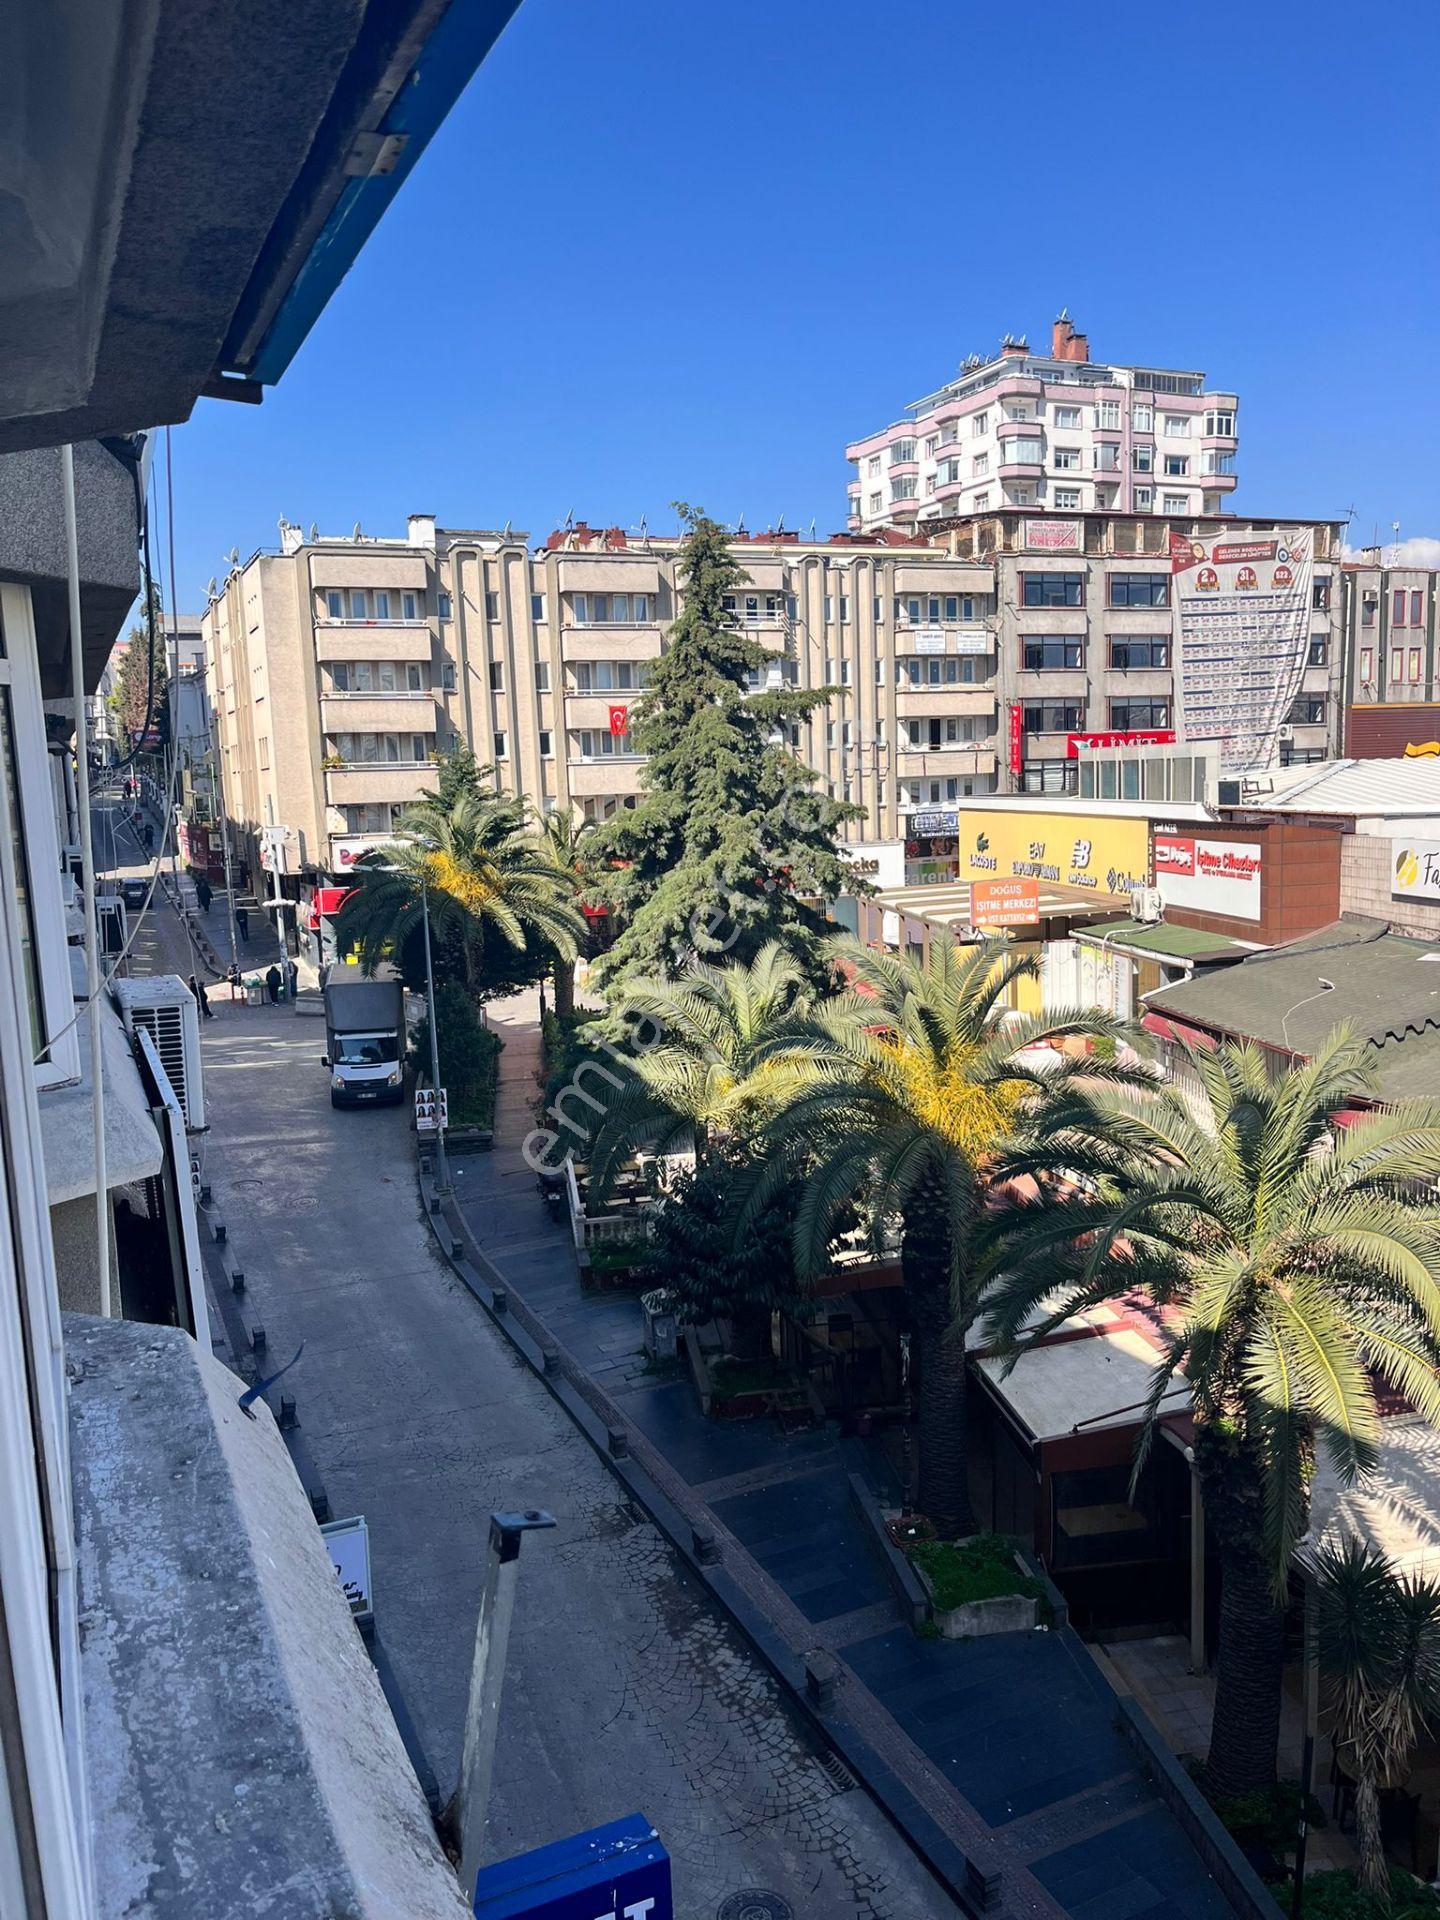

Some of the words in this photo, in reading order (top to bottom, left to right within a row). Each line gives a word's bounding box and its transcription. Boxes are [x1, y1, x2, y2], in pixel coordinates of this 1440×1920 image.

[1201, 569, 1209, 582] 2
[1239, 569, 1250, 581] 31
[969, 854, 998, 872] LACOSTE
[976, 898, 1001, 912] İŞİTME
[1003, 897, 1036, 910] MERKEZİ
